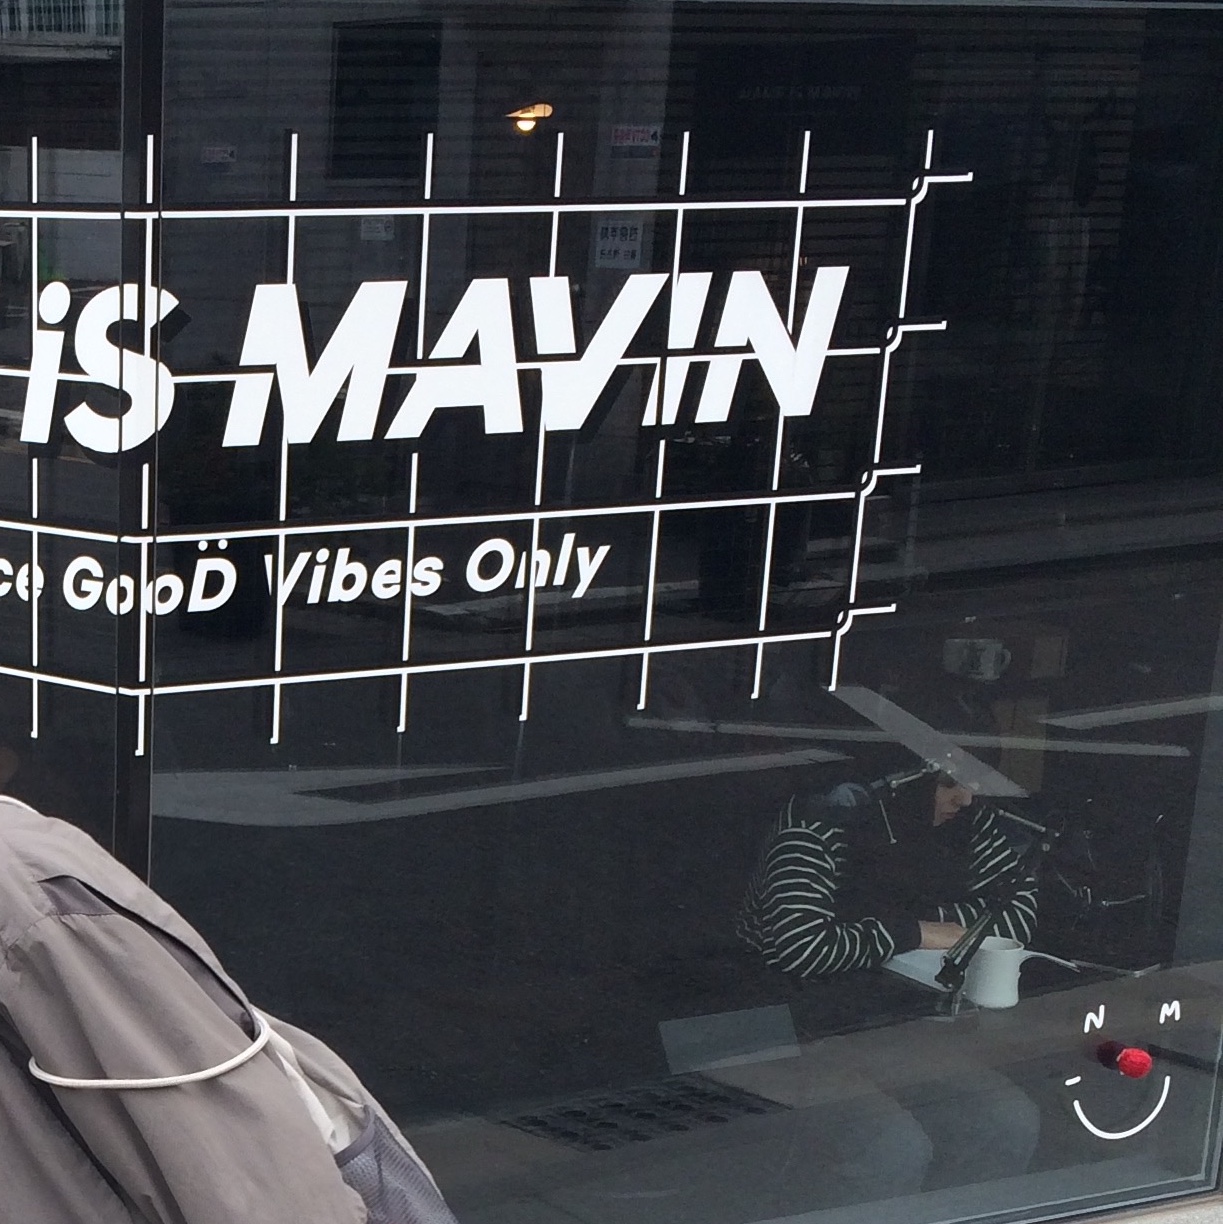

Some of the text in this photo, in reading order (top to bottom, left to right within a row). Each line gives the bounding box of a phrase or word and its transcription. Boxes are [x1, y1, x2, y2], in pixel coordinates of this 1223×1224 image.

[20, 280, 180, 454] iS
[221, 266, 850, 447] MAVIN
[264, 546, 444, 606] Vibes
[465, 533, 611, 599] Only
[1084, 1004, 1105, 1033] N
[1159, 1000, 1181, 1024] M
